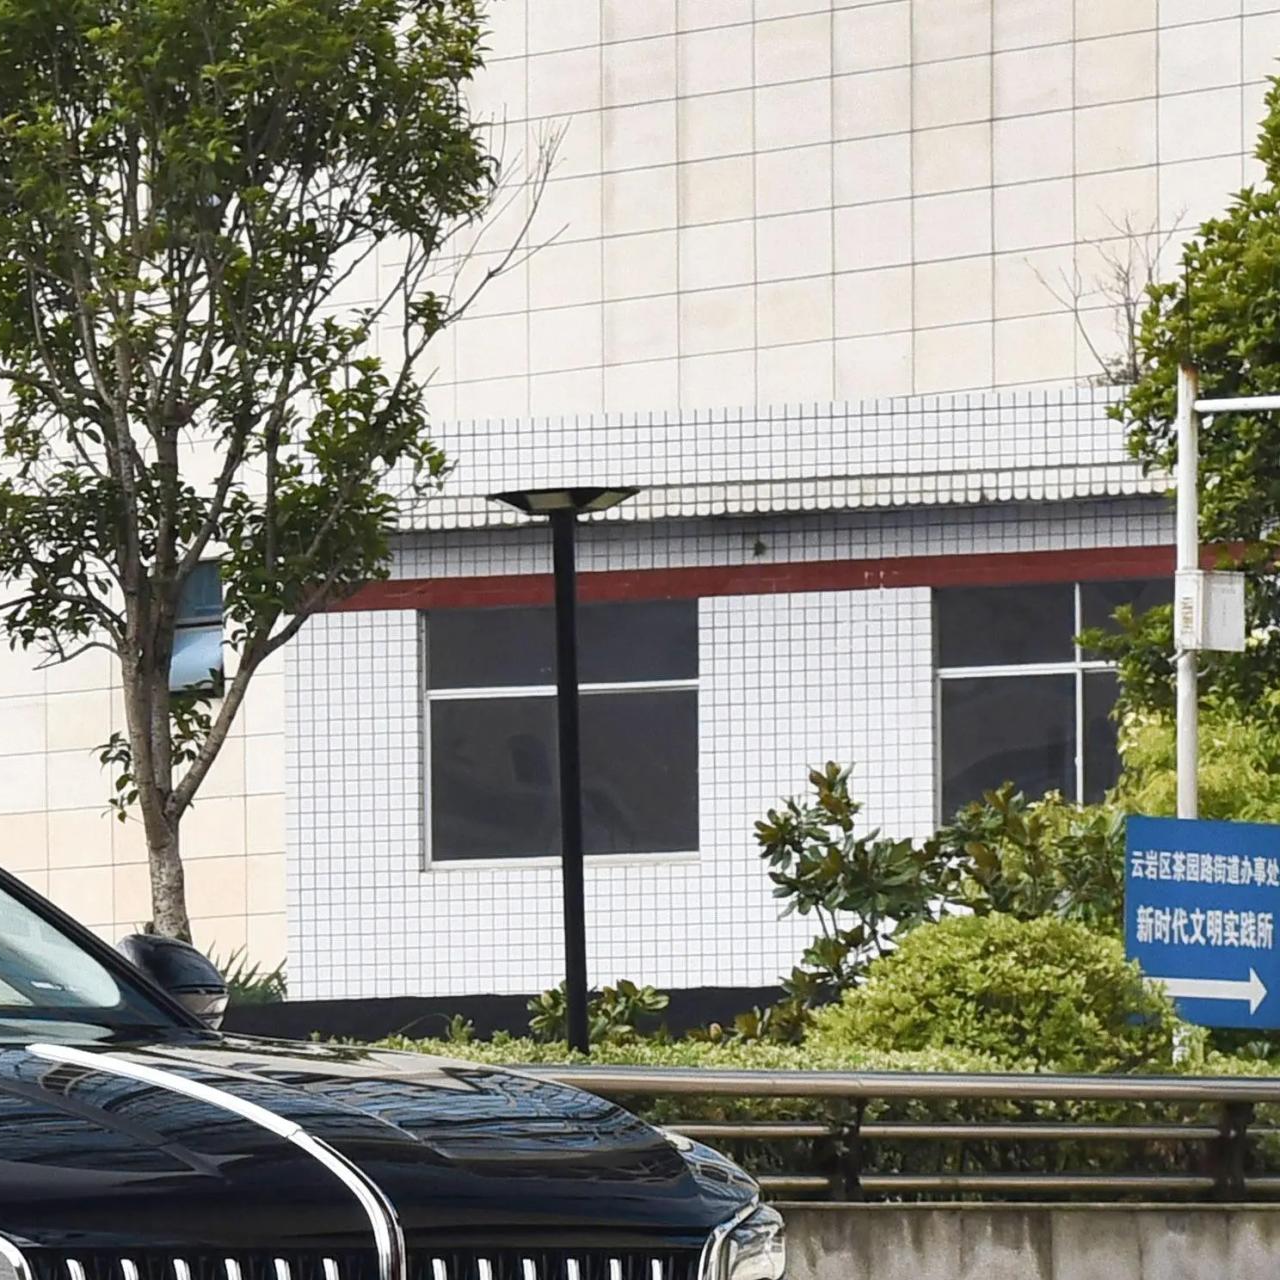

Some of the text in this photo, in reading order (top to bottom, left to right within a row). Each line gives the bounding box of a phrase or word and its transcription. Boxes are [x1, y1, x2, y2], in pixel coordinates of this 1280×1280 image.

[1131, 850, 1280, 886] 云岩区茶园路街道办事处
[1136, 904, 1273, 949] 新时代文明实践所
